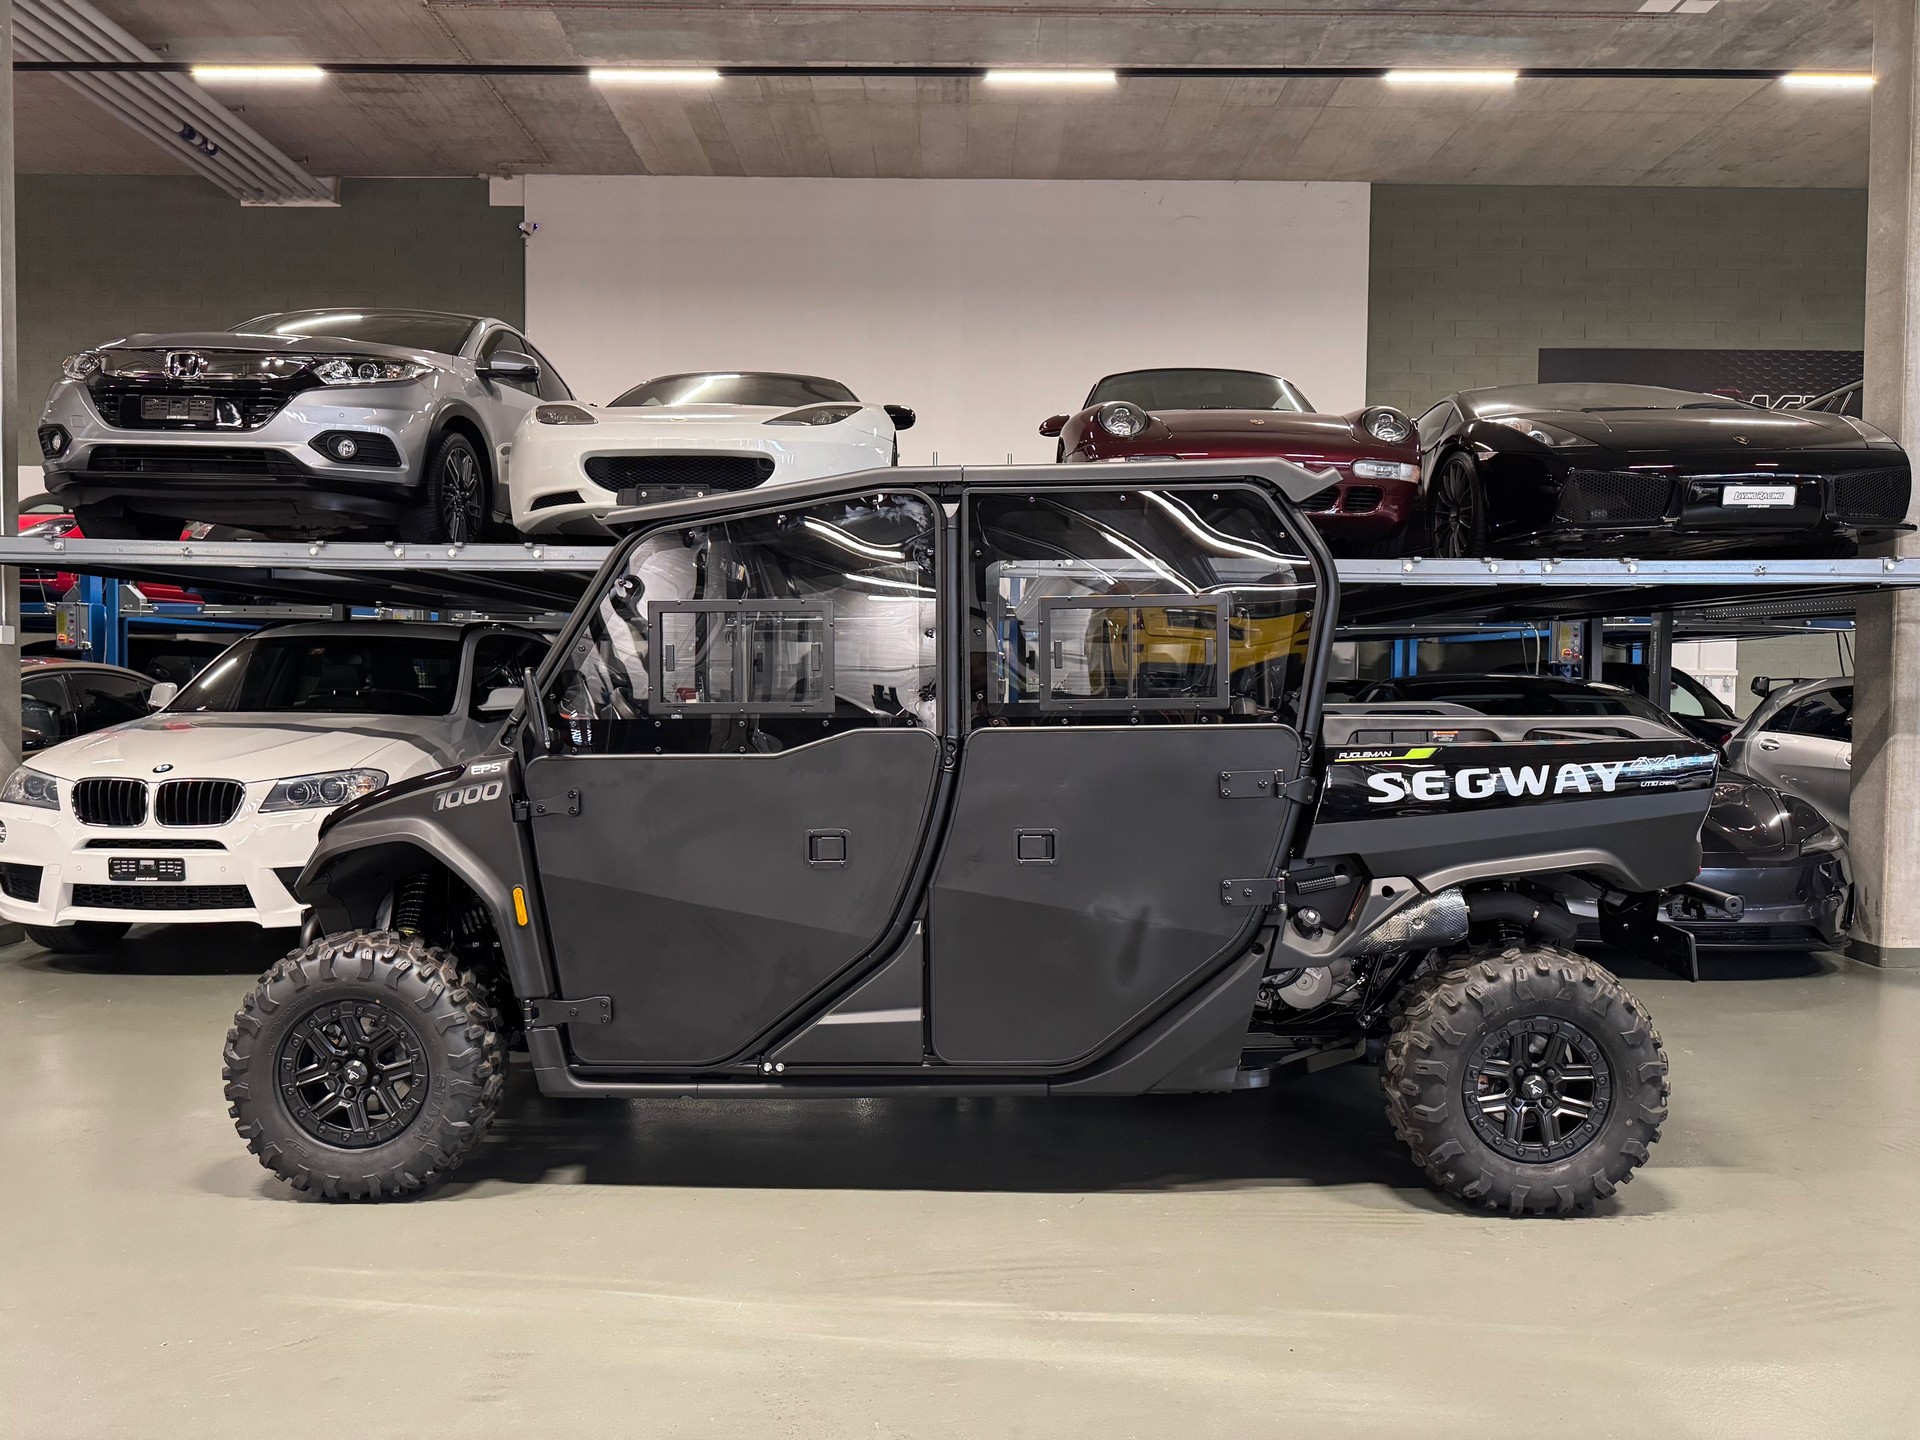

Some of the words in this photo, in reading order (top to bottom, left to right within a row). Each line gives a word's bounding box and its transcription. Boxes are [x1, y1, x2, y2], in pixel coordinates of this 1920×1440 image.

[1338, 750, 1393, 760] FUGLEMAN
[470, 762, 502, 775] EPS
[1367, 762, 1620, 804] SEGWAY
[432, 779, 504, 813] 1000
